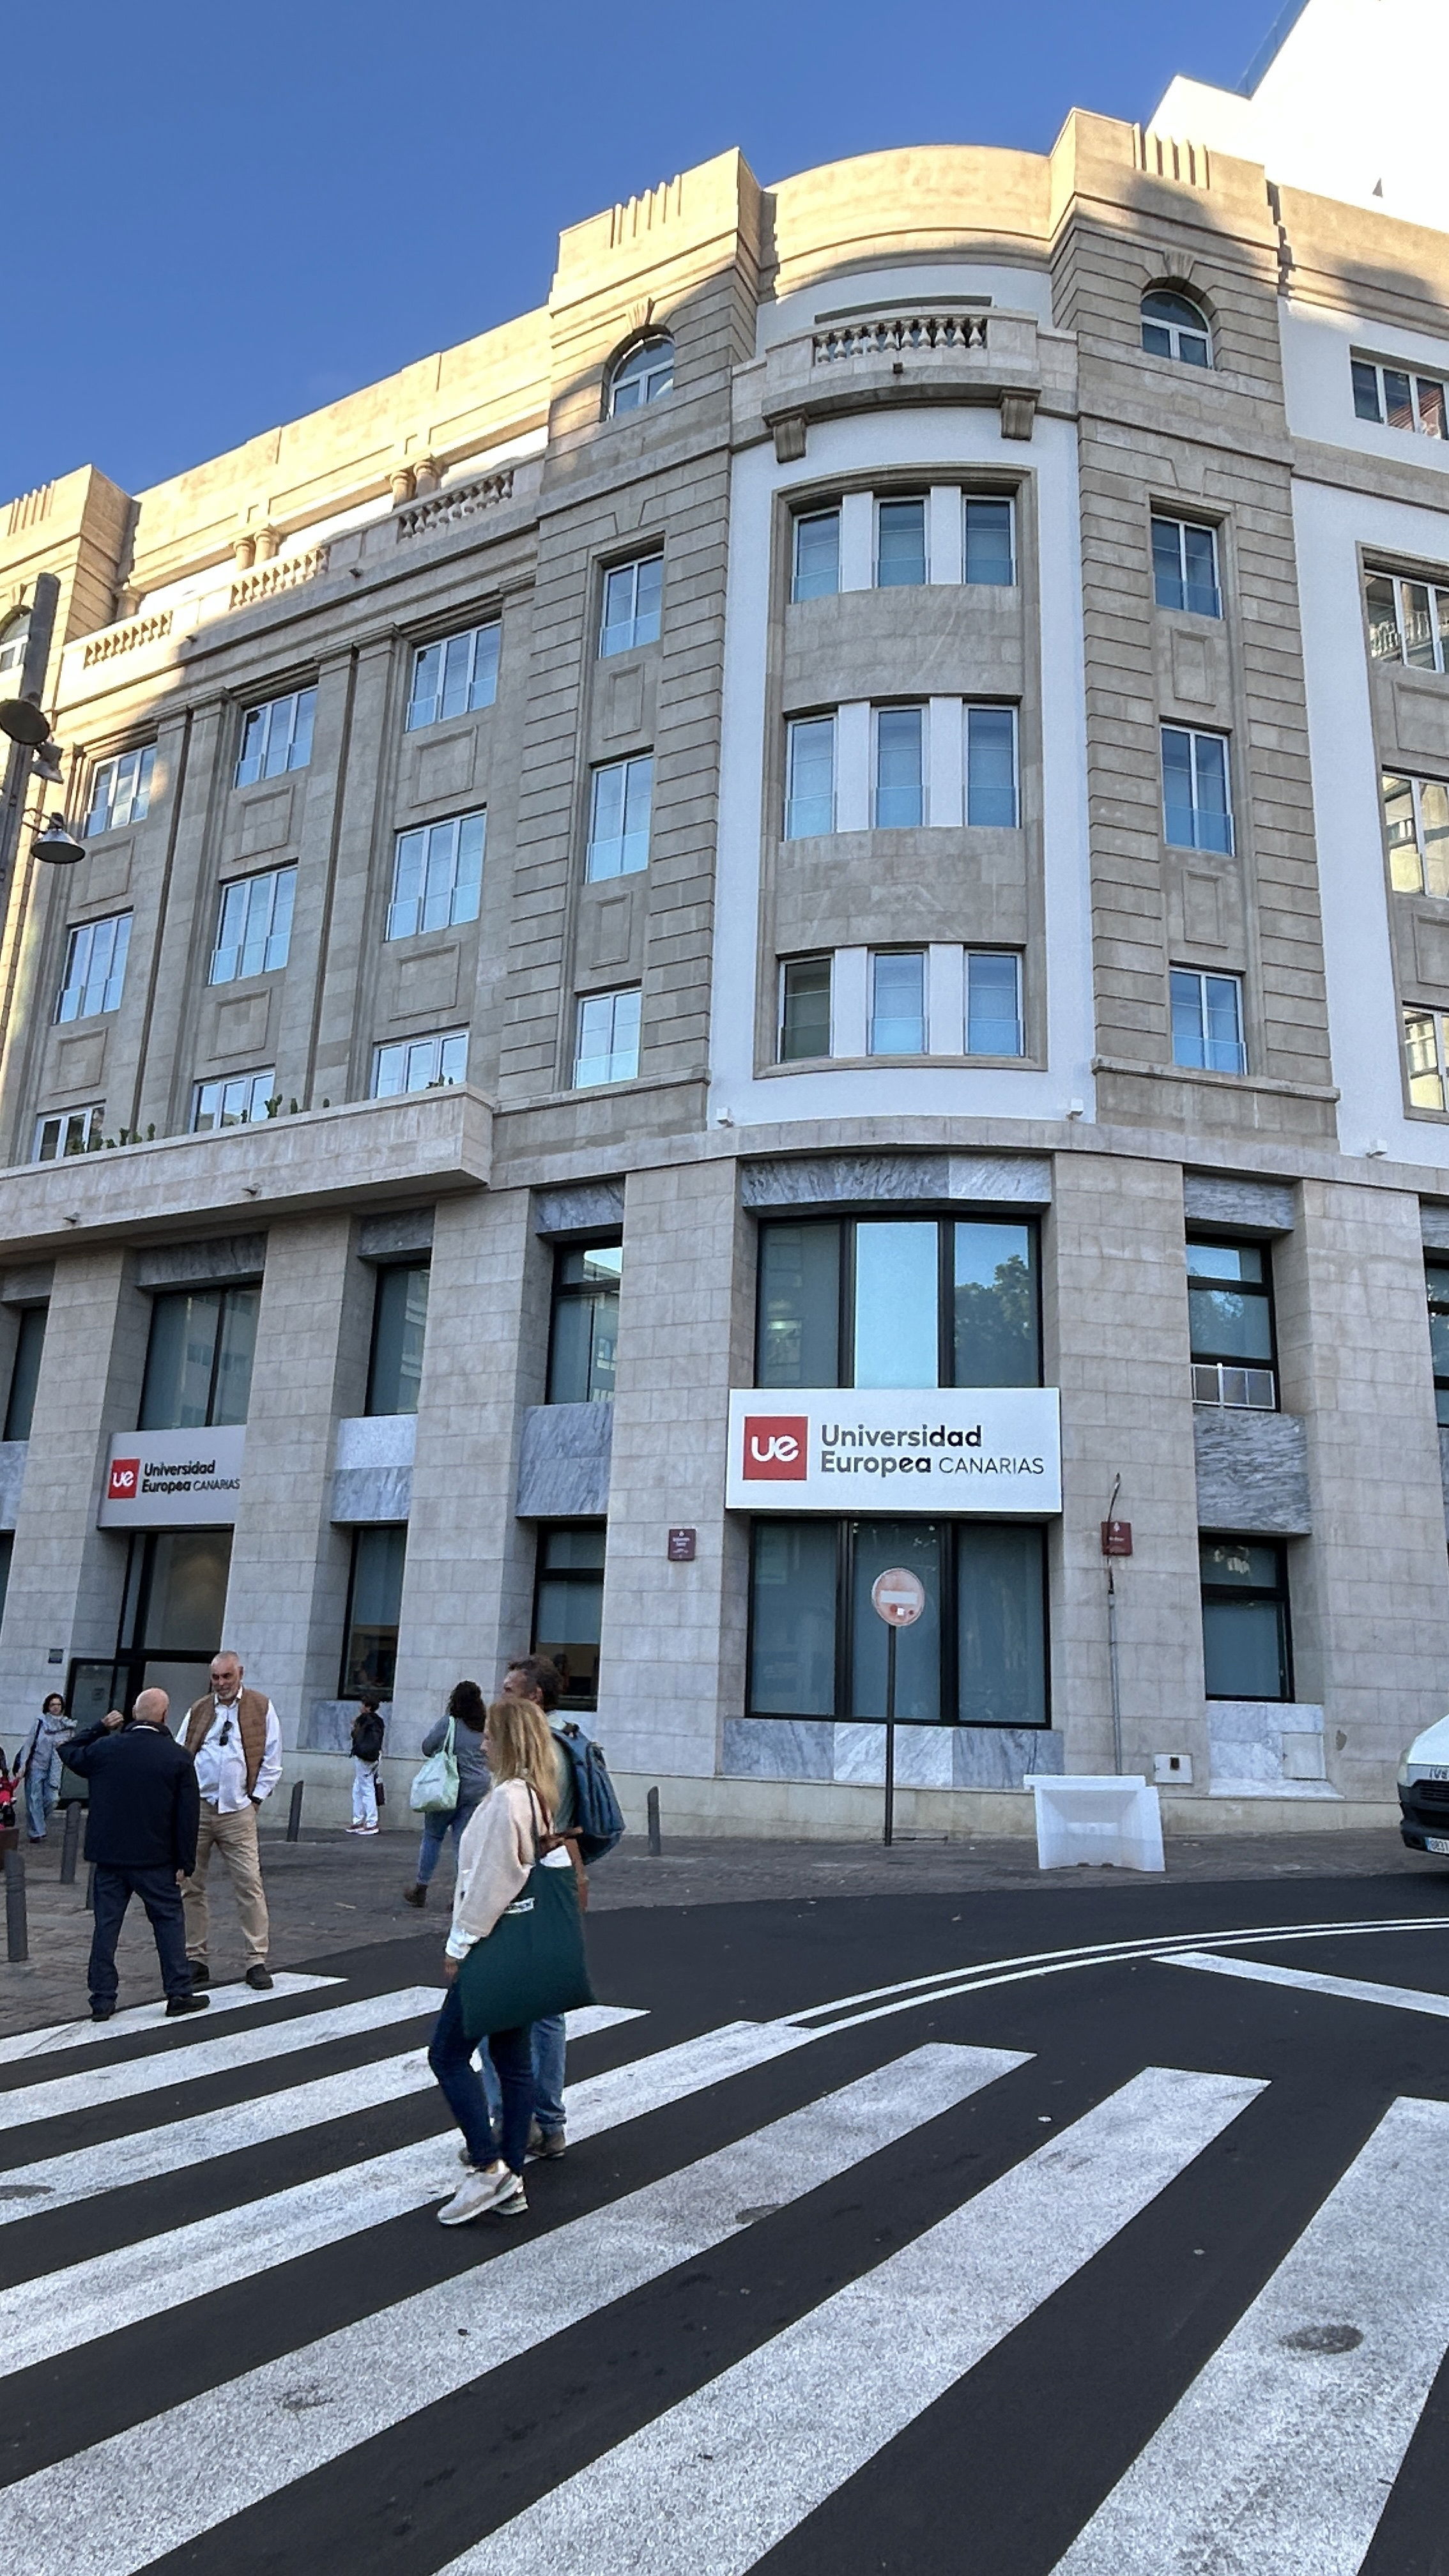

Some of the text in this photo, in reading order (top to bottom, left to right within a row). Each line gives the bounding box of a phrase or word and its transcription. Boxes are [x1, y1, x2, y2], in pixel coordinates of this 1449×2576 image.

[821, 1423, 982, 1447] Universidad
[750, 1434, 799, 1462] ue
[144, 1459, 216, 1476] Universidad
[820, 1450, 1045, 1478] Europea CANARIAS
[112, 1471, 134, 1488] ue
[141, 1478, 241, 1494] Europea CANARIAS
